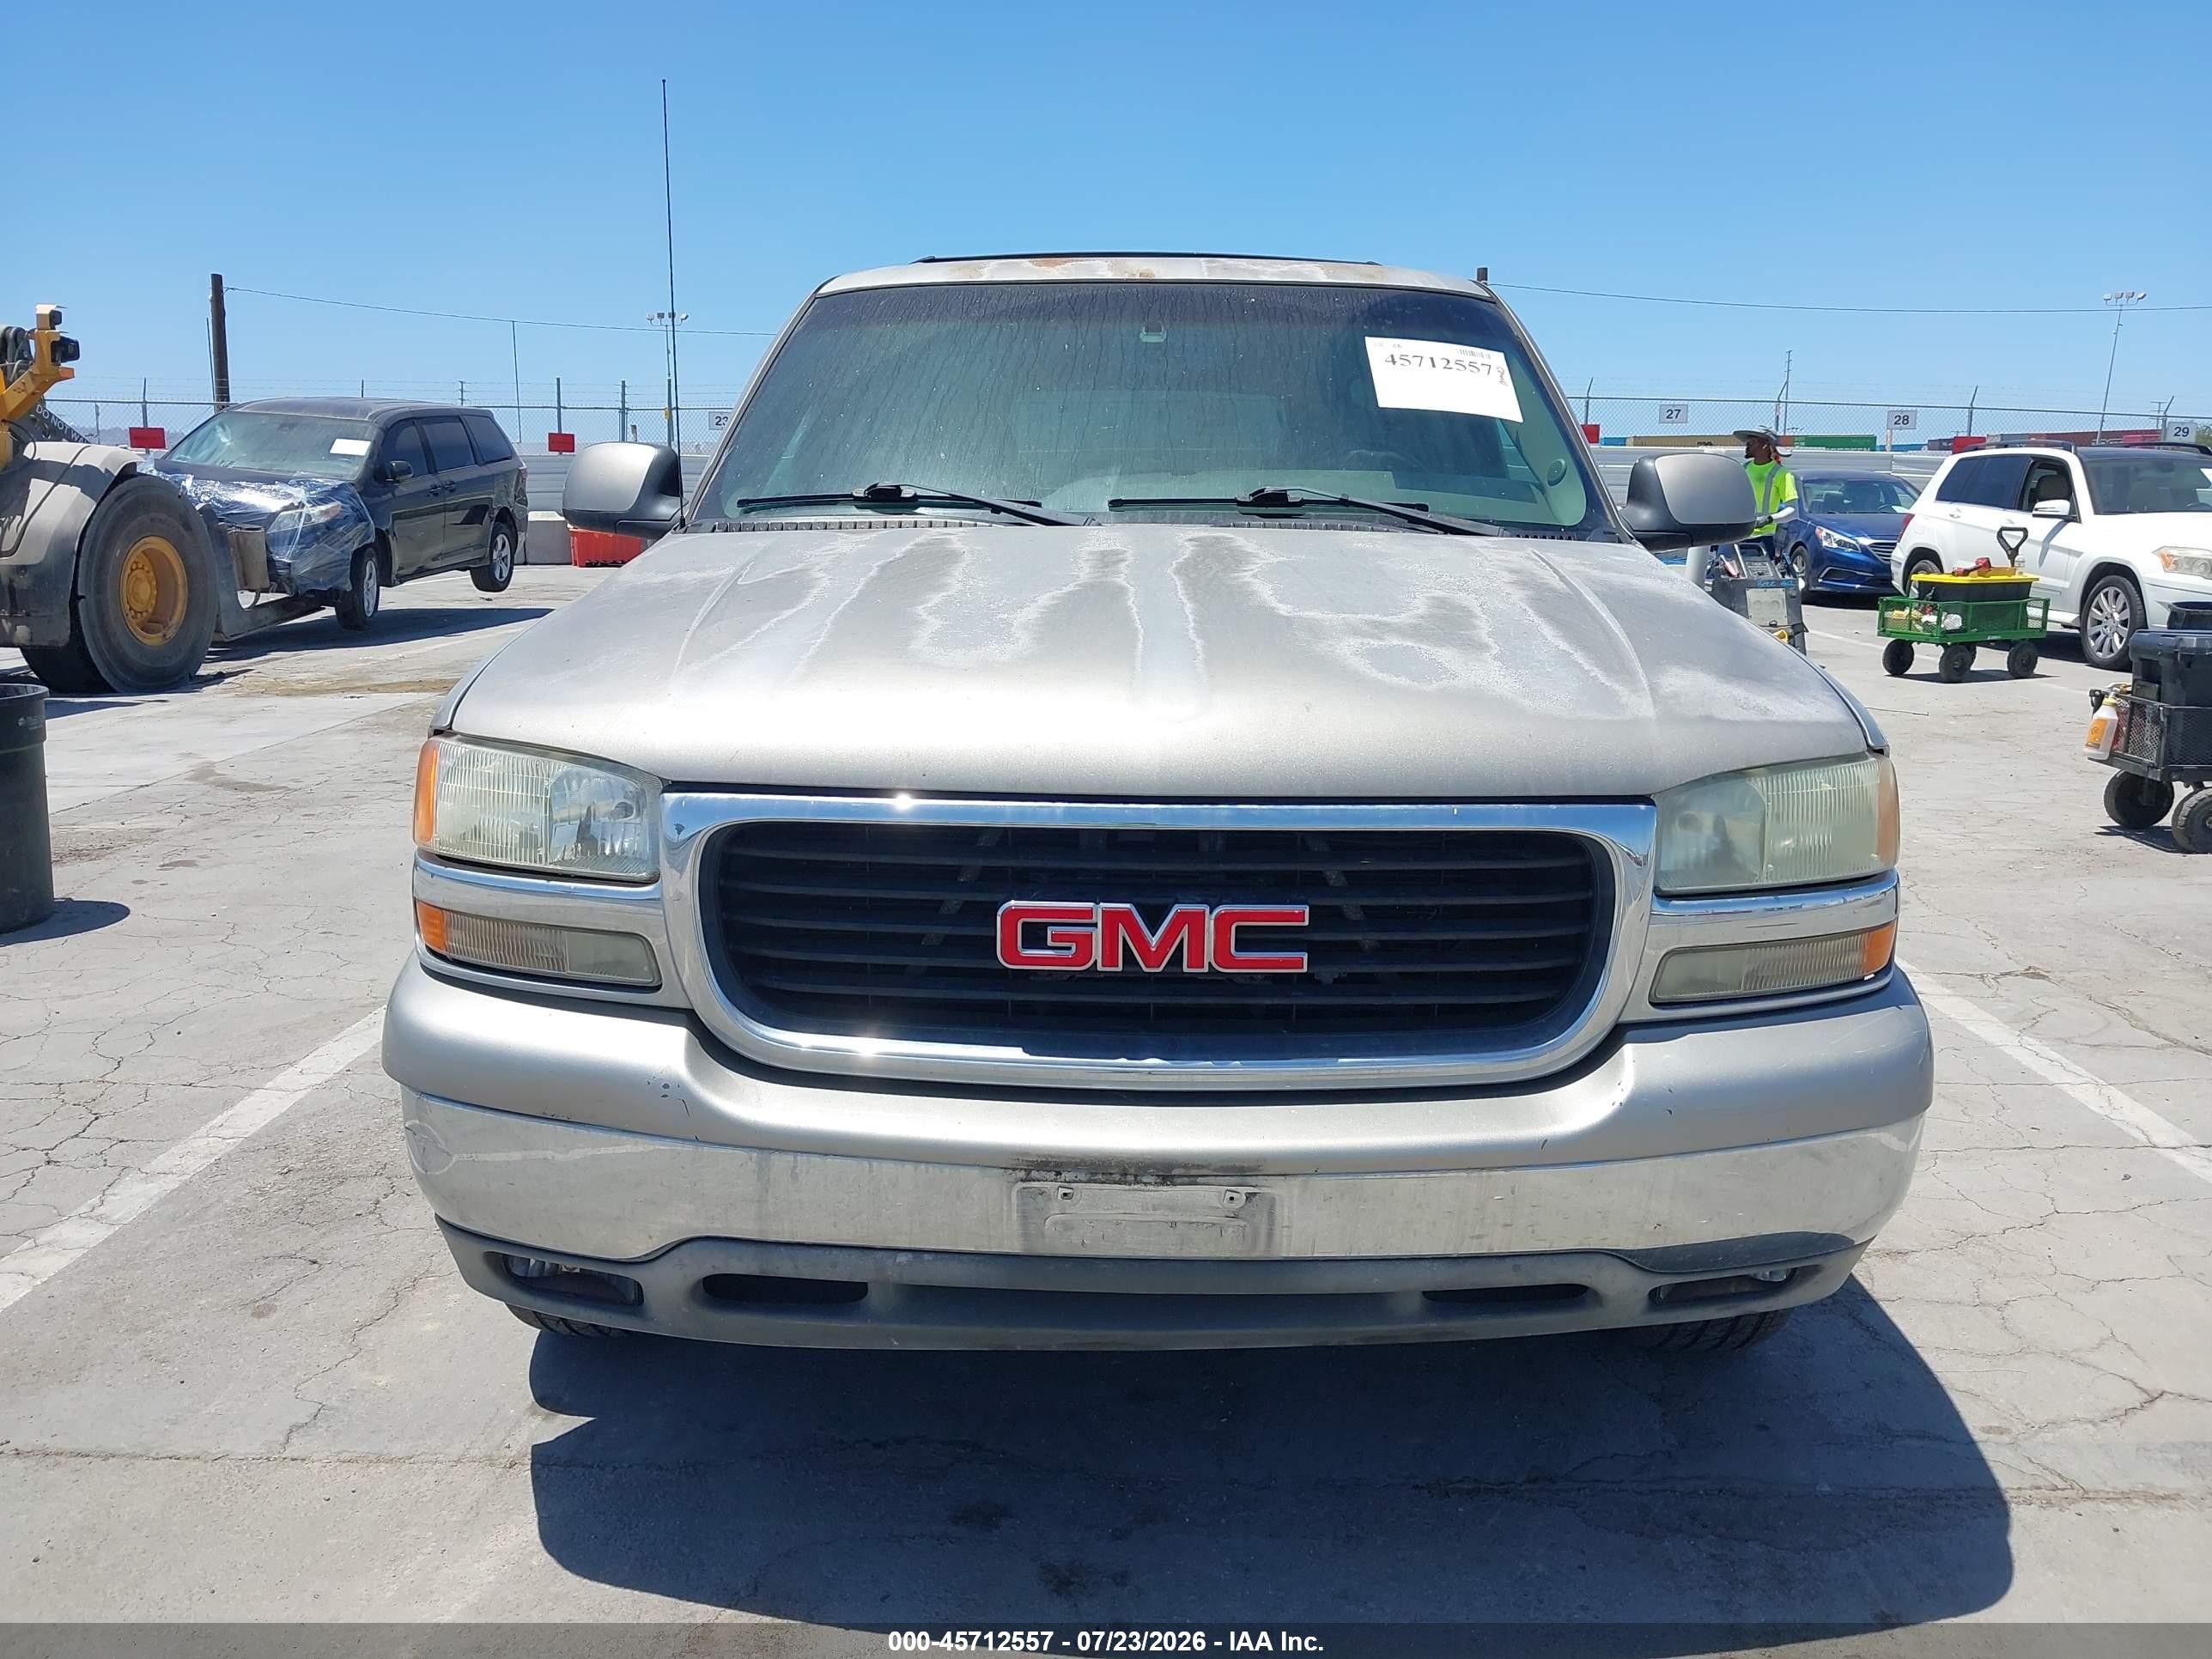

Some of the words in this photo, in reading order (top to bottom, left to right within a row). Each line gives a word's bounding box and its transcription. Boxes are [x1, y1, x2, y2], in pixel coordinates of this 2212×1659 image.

[1384, 353, 1492, 375] 45712557
[35, 404, 50, 419] DO
[51, 415, 70, 434] NOT
[1665, 408, 1682, 420] 27
[1893, 414, 1910, 426] 28
[2173, 426, 2190, 438] 29
[996, 900, 1310, 973] GMC
